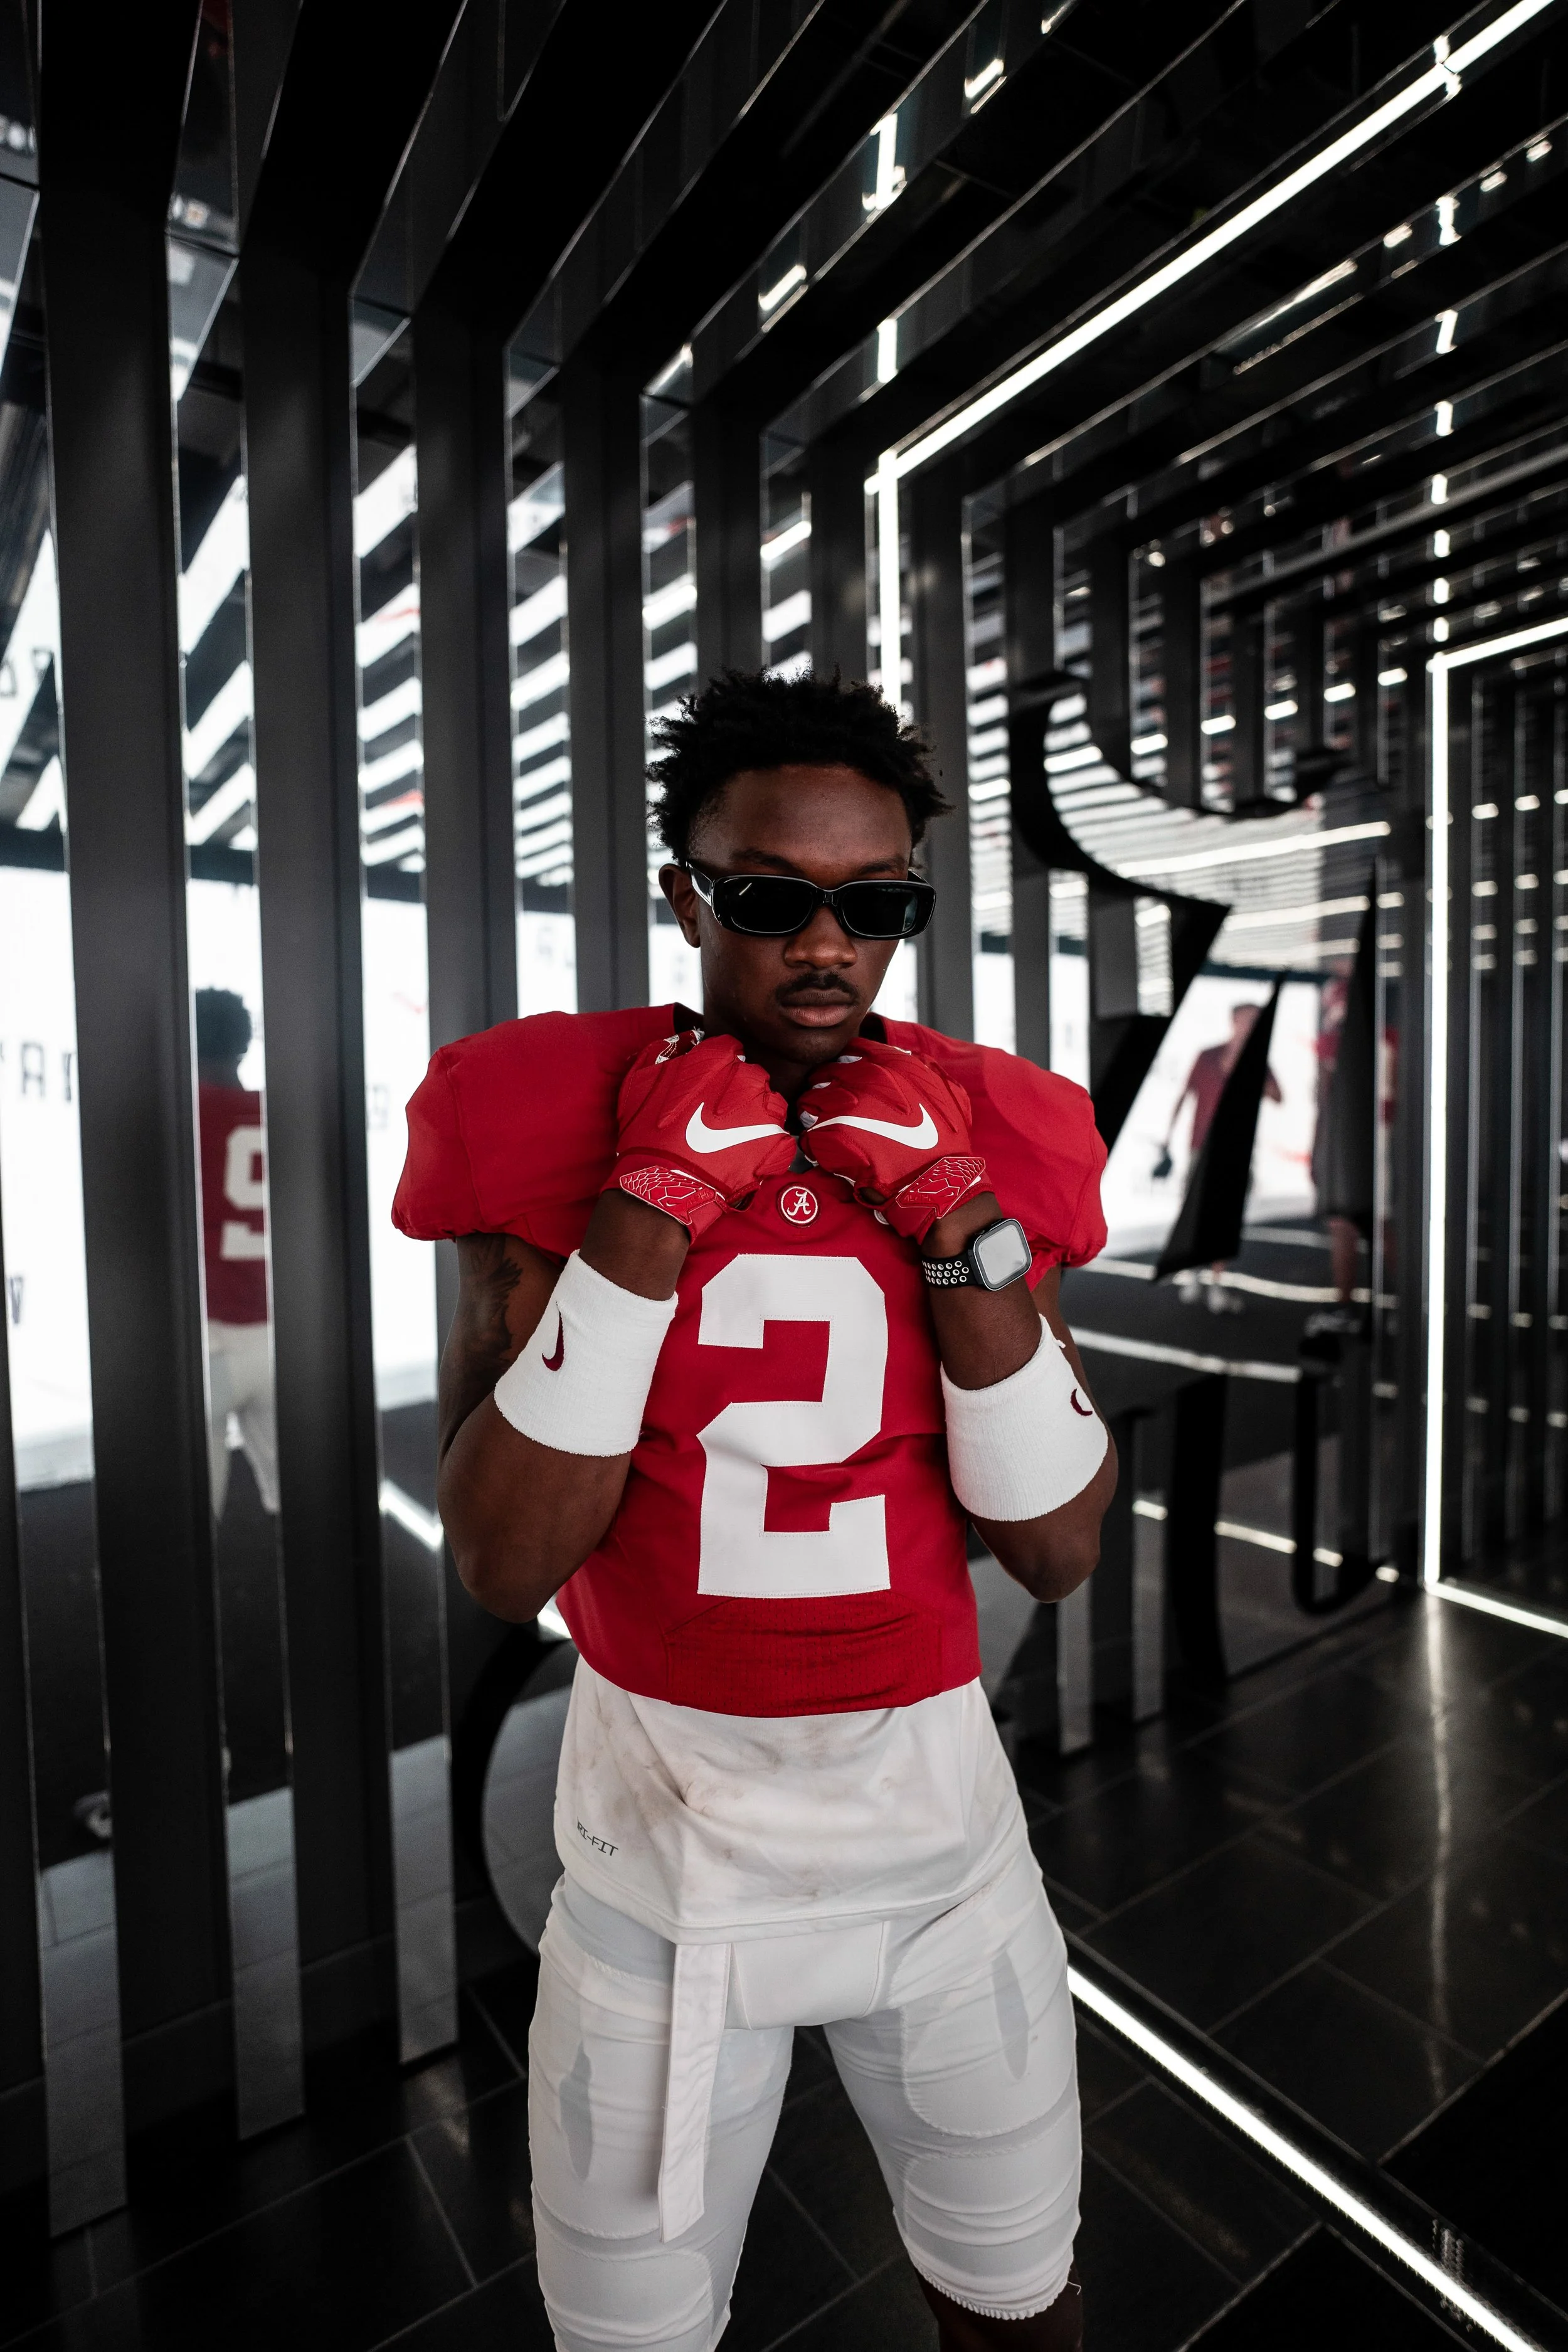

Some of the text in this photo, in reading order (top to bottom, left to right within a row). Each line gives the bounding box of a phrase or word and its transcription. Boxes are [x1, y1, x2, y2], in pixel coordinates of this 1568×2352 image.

[787, 1190, 812, 1216] A
[696, 1254, 891, 1598] 2
[577, 1816, 618, 1857] RI-FIT
